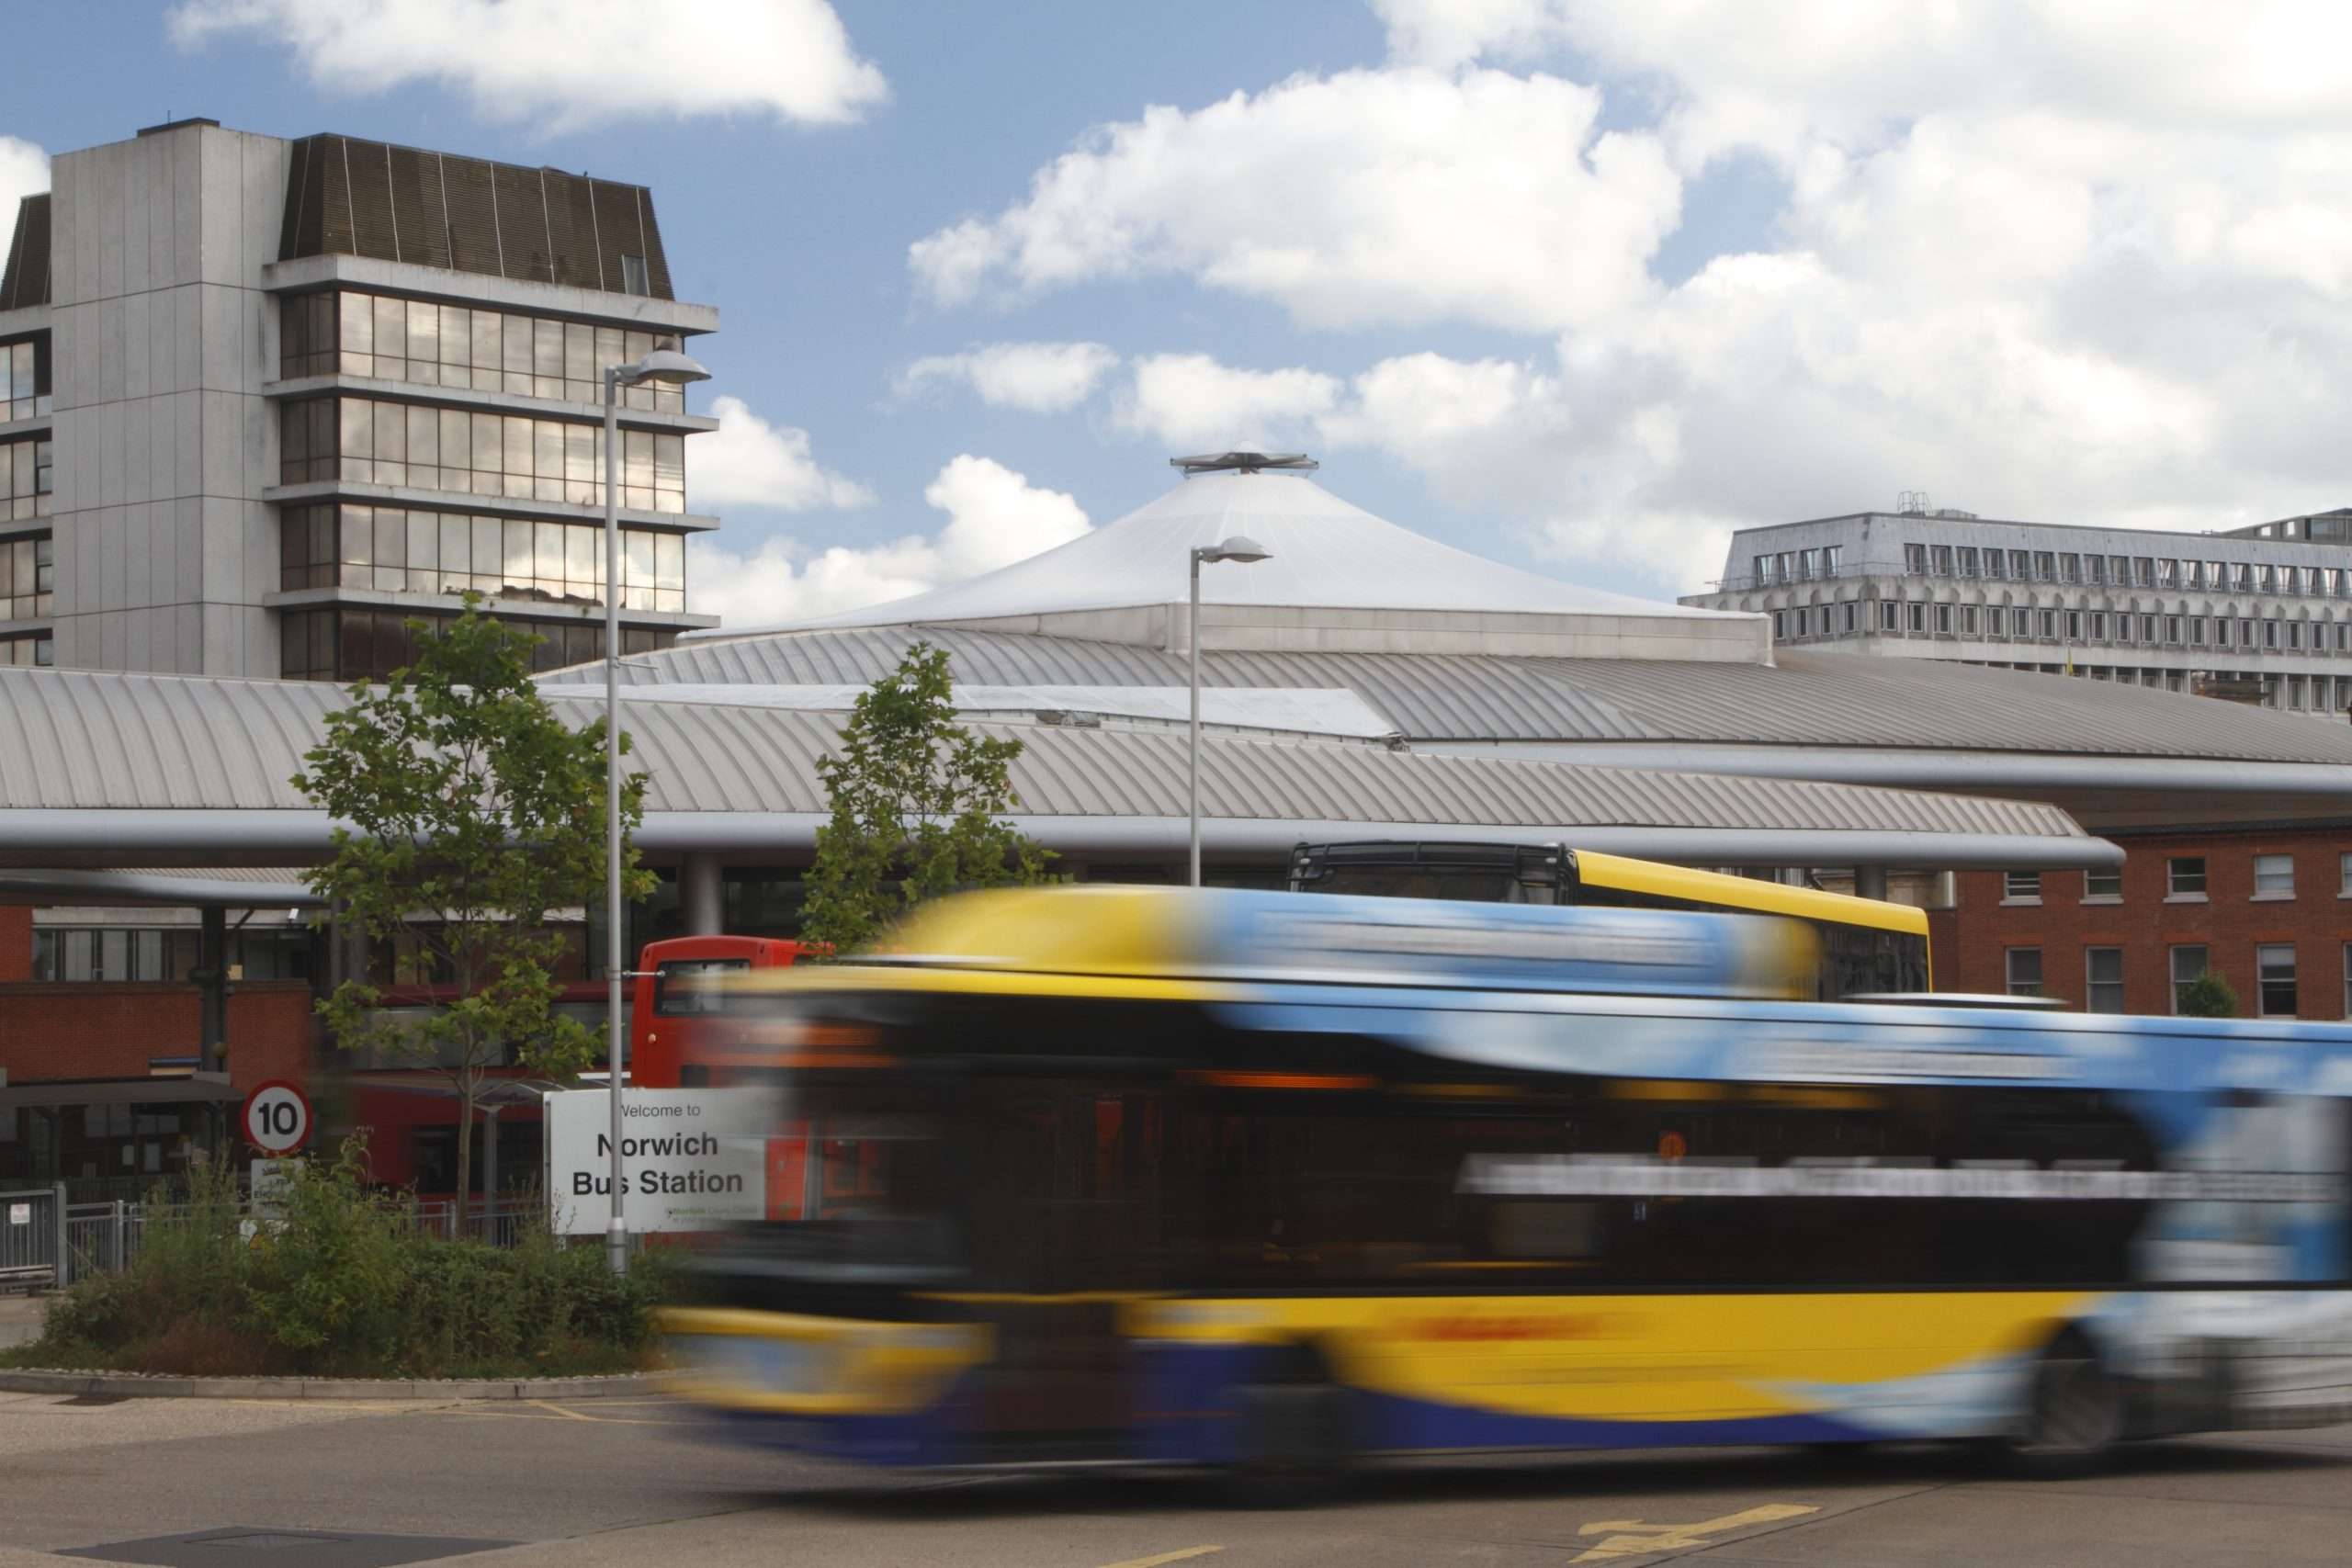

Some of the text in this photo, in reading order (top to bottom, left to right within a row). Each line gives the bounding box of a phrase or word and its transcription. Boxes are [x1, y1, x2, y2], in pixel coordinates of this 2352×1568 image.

[258, 1101, 298, 1135] 10
[687, 1104, 701, 1116] to
[597, 1132, 718, 1156] Norwich
[639, 1169, 742, 1194] Station
